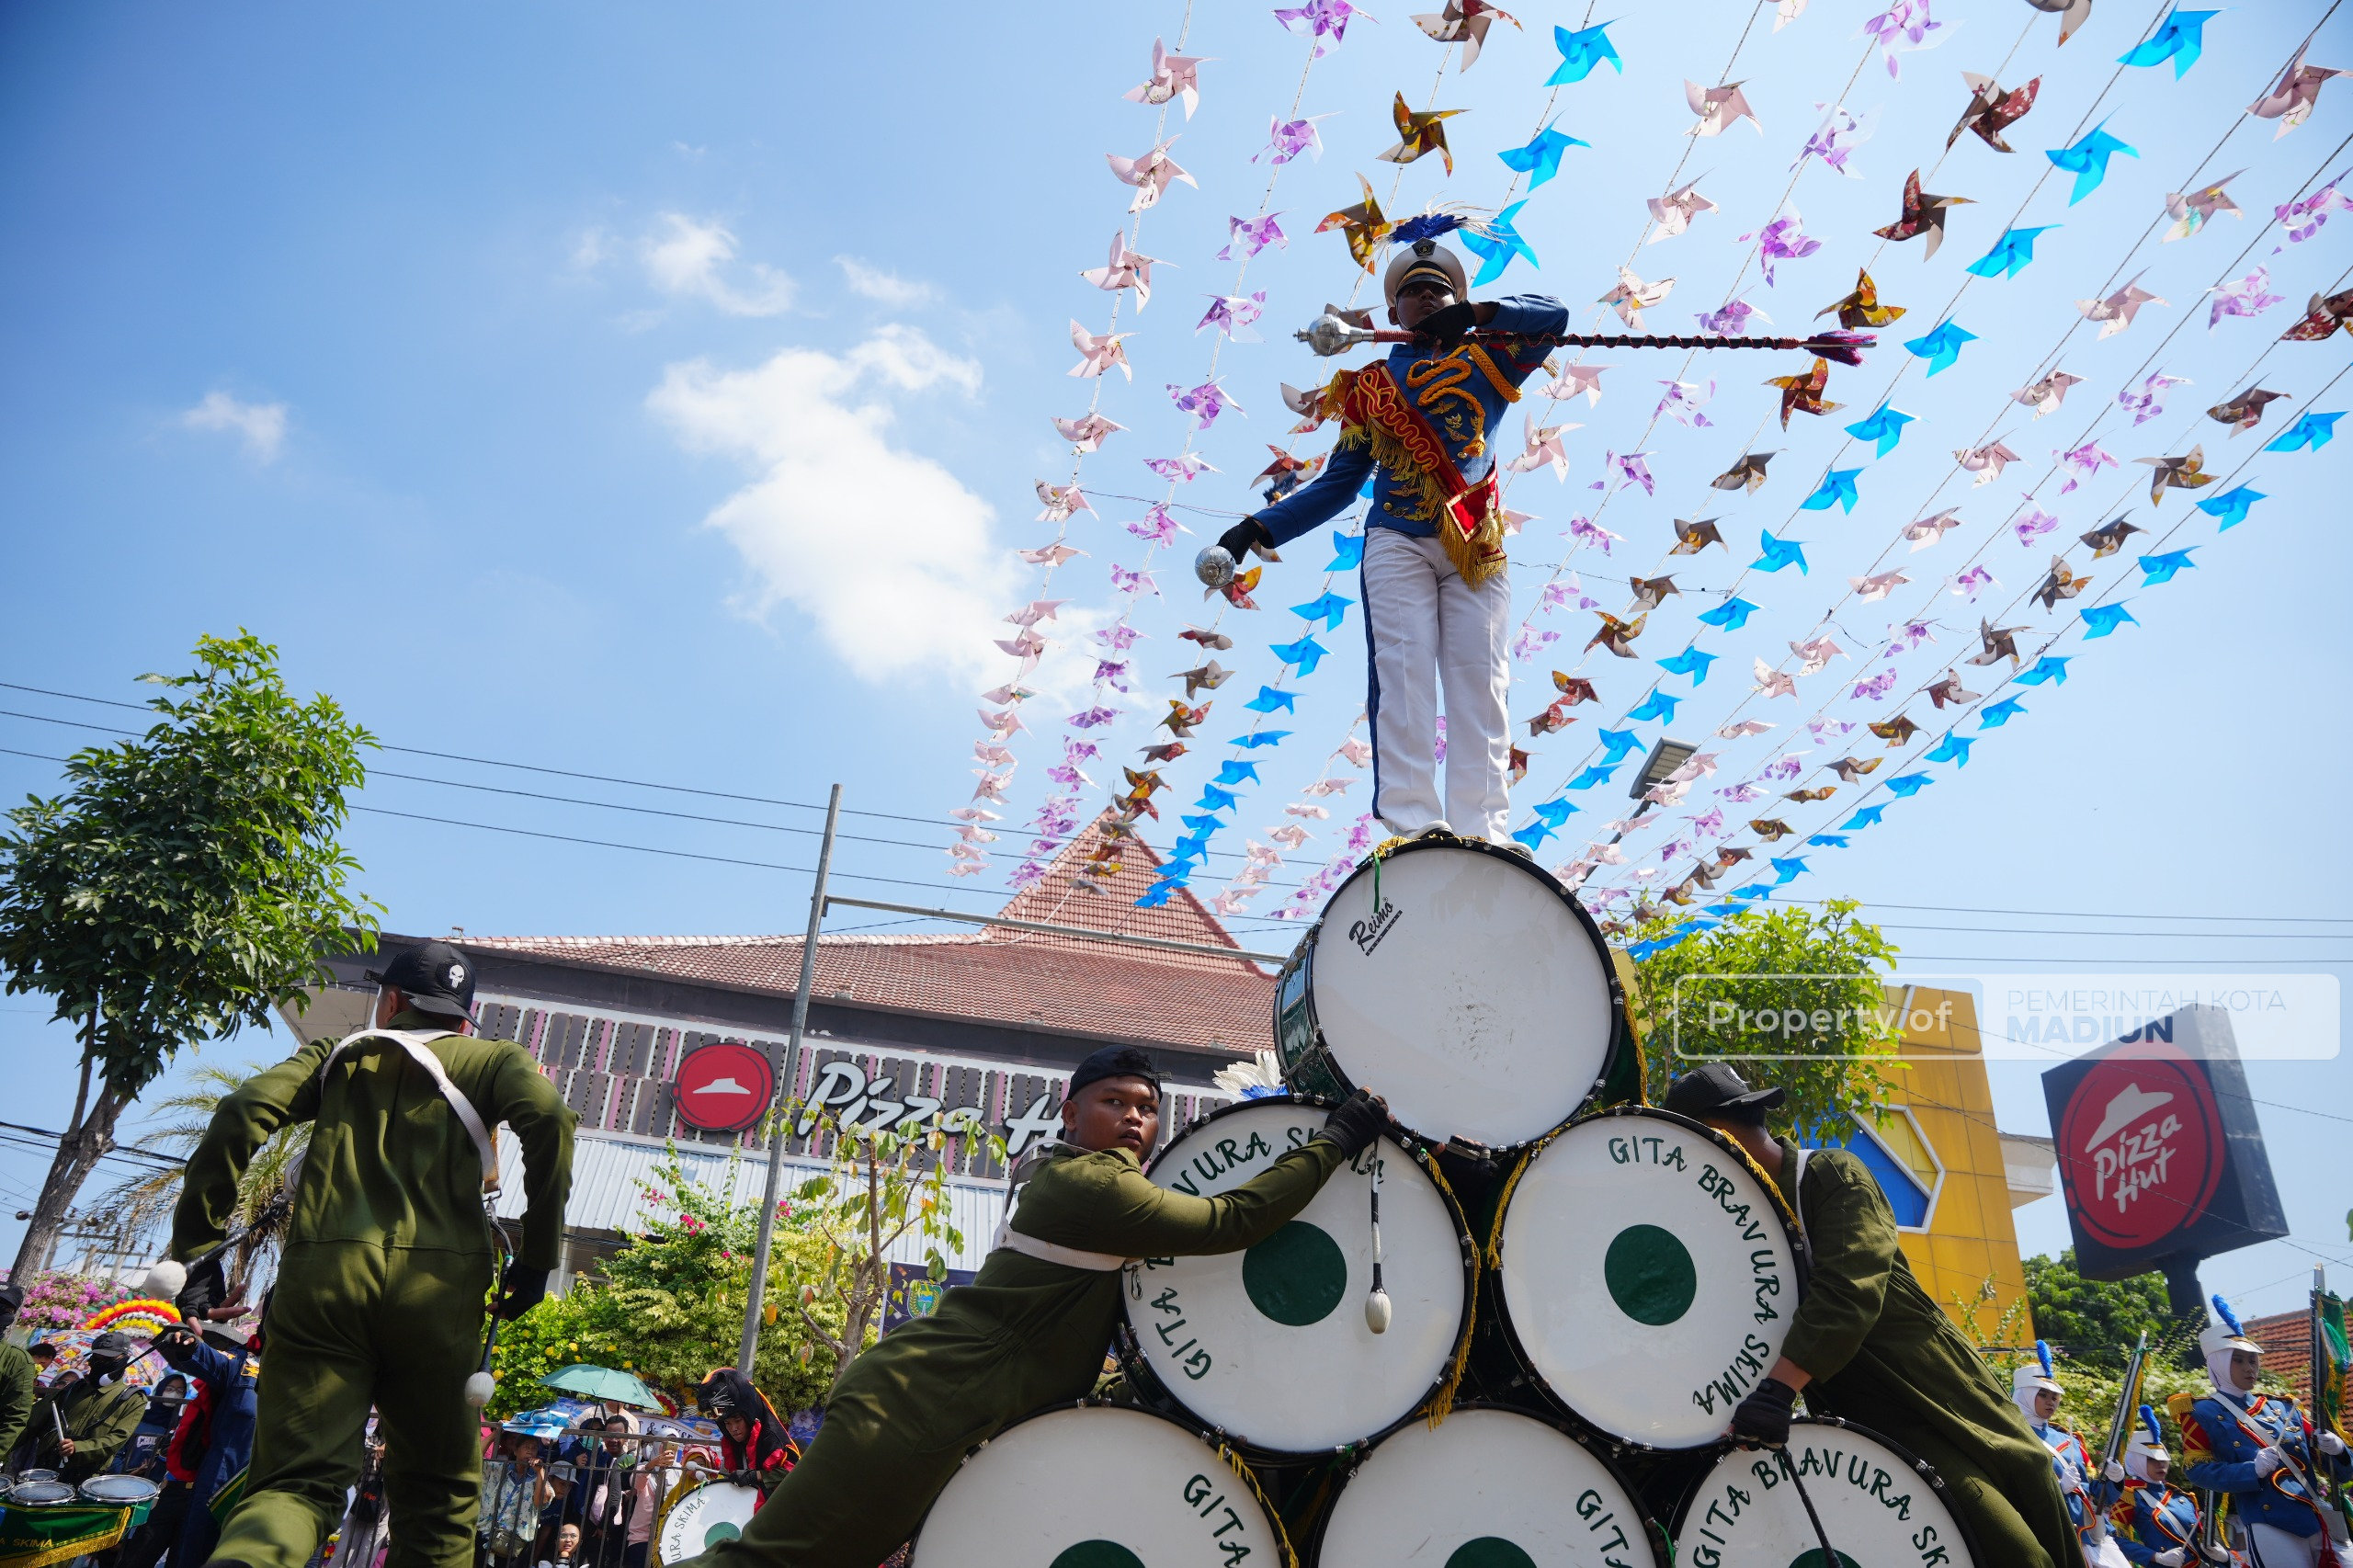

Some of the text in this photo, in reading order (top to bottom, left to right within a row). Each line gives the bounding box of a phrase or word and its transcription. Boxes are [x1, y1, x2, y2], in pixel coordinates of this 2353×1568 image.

[1348, 902, 1393, 952] Reimo
[795, 1062, 986, 1143] Pizza
[2112, 1146, 2177, 1214] Hut
[1608, 1135, 1781, 1415] GITA BRAVURA SKIMA
[1151, 1287, 1212, 1381] GITA
[674, 1497, 706, 1529] SKIMA
[1183, 1473, 1251, 1568] GITA
[1693, 1484, 1751, 1568] GITA
